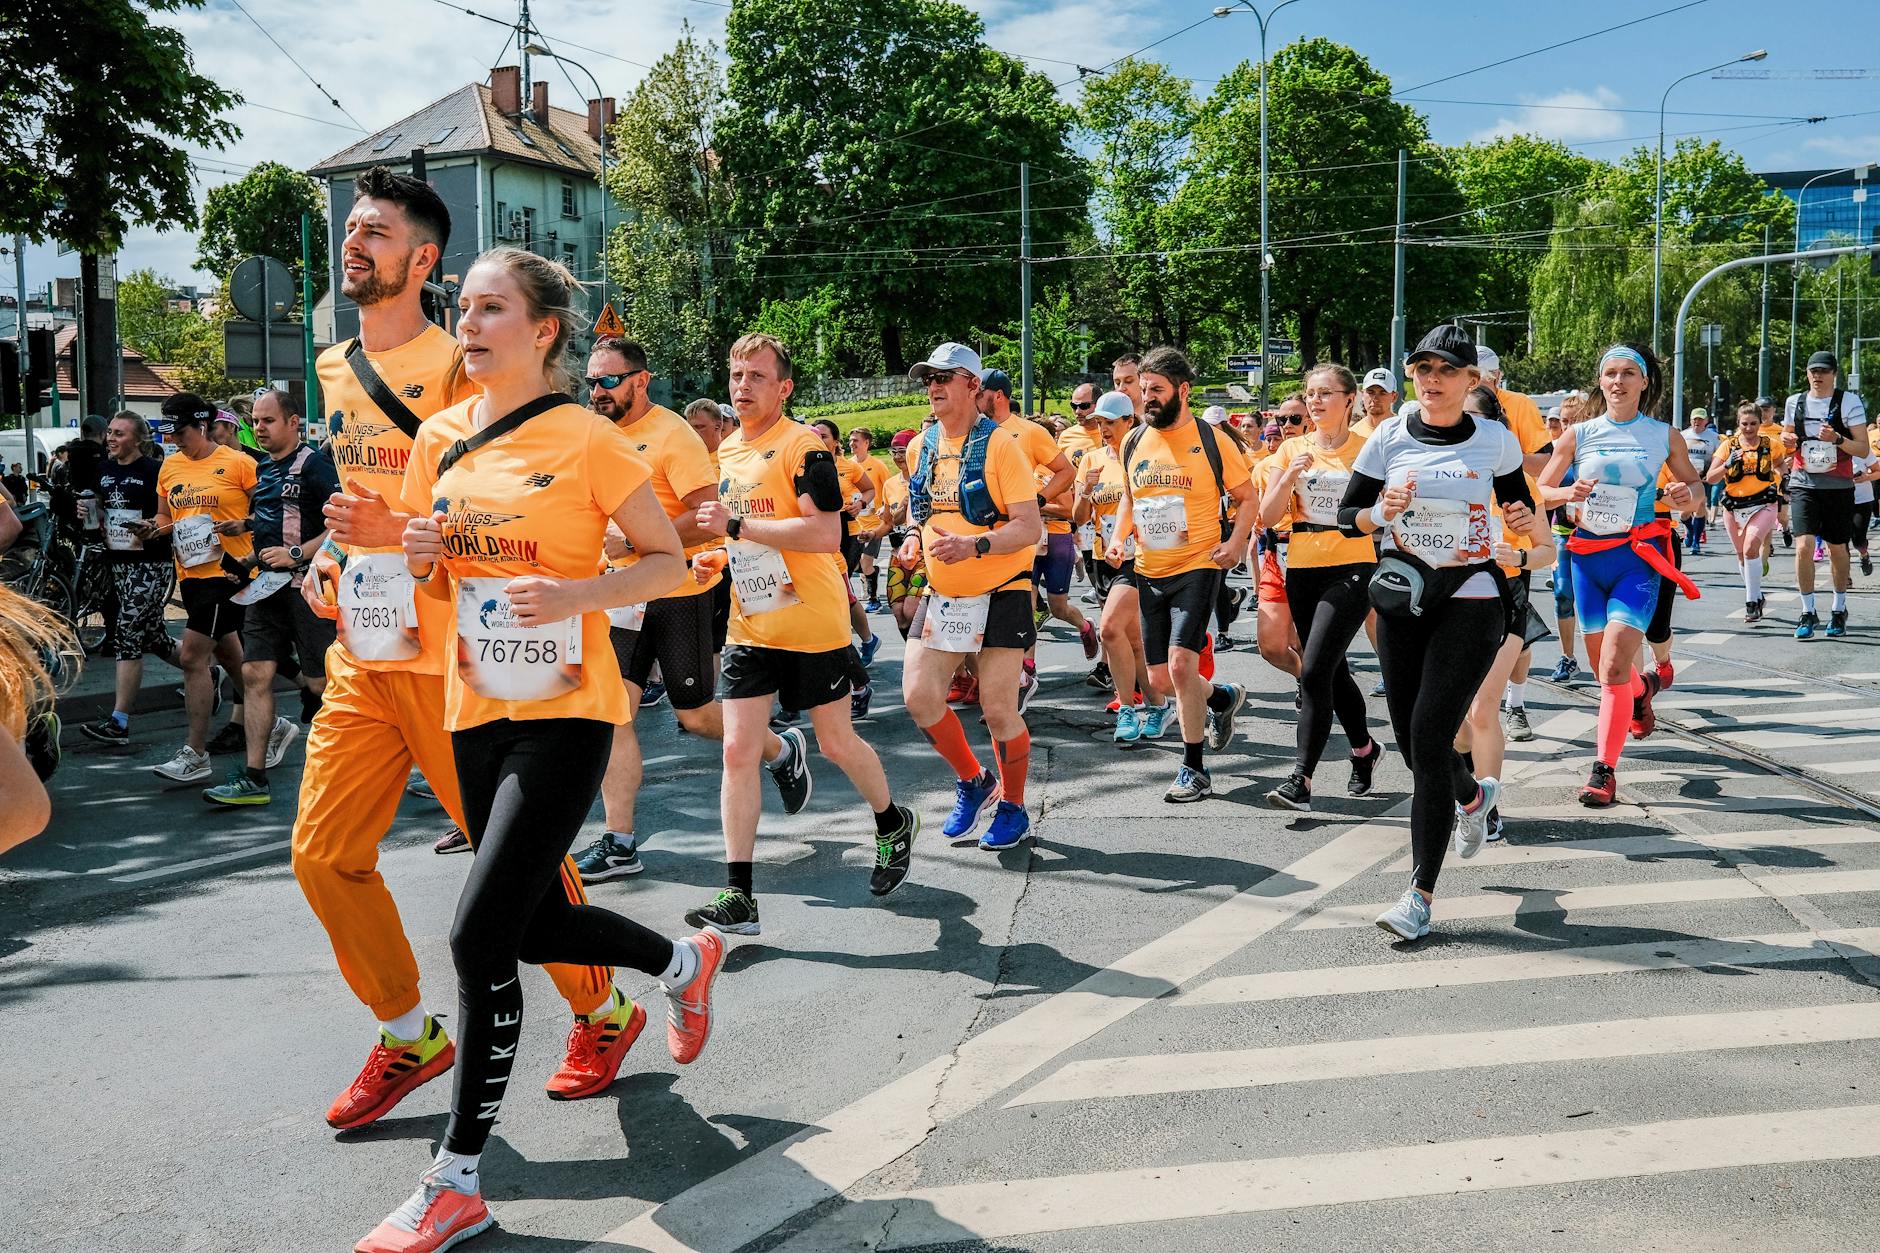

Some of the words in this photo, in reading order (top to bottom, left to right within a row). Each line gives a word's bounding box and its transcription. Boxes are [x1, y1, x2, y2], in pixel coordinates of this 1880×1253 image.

[335, 444, 377, 467] WORLD
[377, 447, 411, 469] RUN
[1139, 474, 1171, 486] WORLD
[1172, 475, 1192, 487] RUN
[1435, 470, 1462, 479] ING
[175, 495, 201, 508] WORLD
[202, 495, 219, 506] RUN
[932, 491, 958, 502] ORLD
[750, 497, 775, 514] RUN
[448, 511, 492, 525] WINGS
[1586, 510, 1619, 524] 9796
[454, 524, 479, 534] LIFE
[1143, 521, 1177, 535] 19266
[1180, 520, 1187, 529] 3
[1400, 532, 1454, 549] 23862
[1460, 536, 1467, 546] 4
[498, 537, 537, 562] RUN
[782, 570, 789, 580] 4
[736, 573, 777, 594] 11004
[351, 607, 399, 628] 79631
[503, 611, 518, 620] LIF
[941, 620, 972, 634] 7596
[978, 623, 985, 632] 3
[477, 638, 558, 664] 76758
[476, 1009, 520, 1120] NIKE
